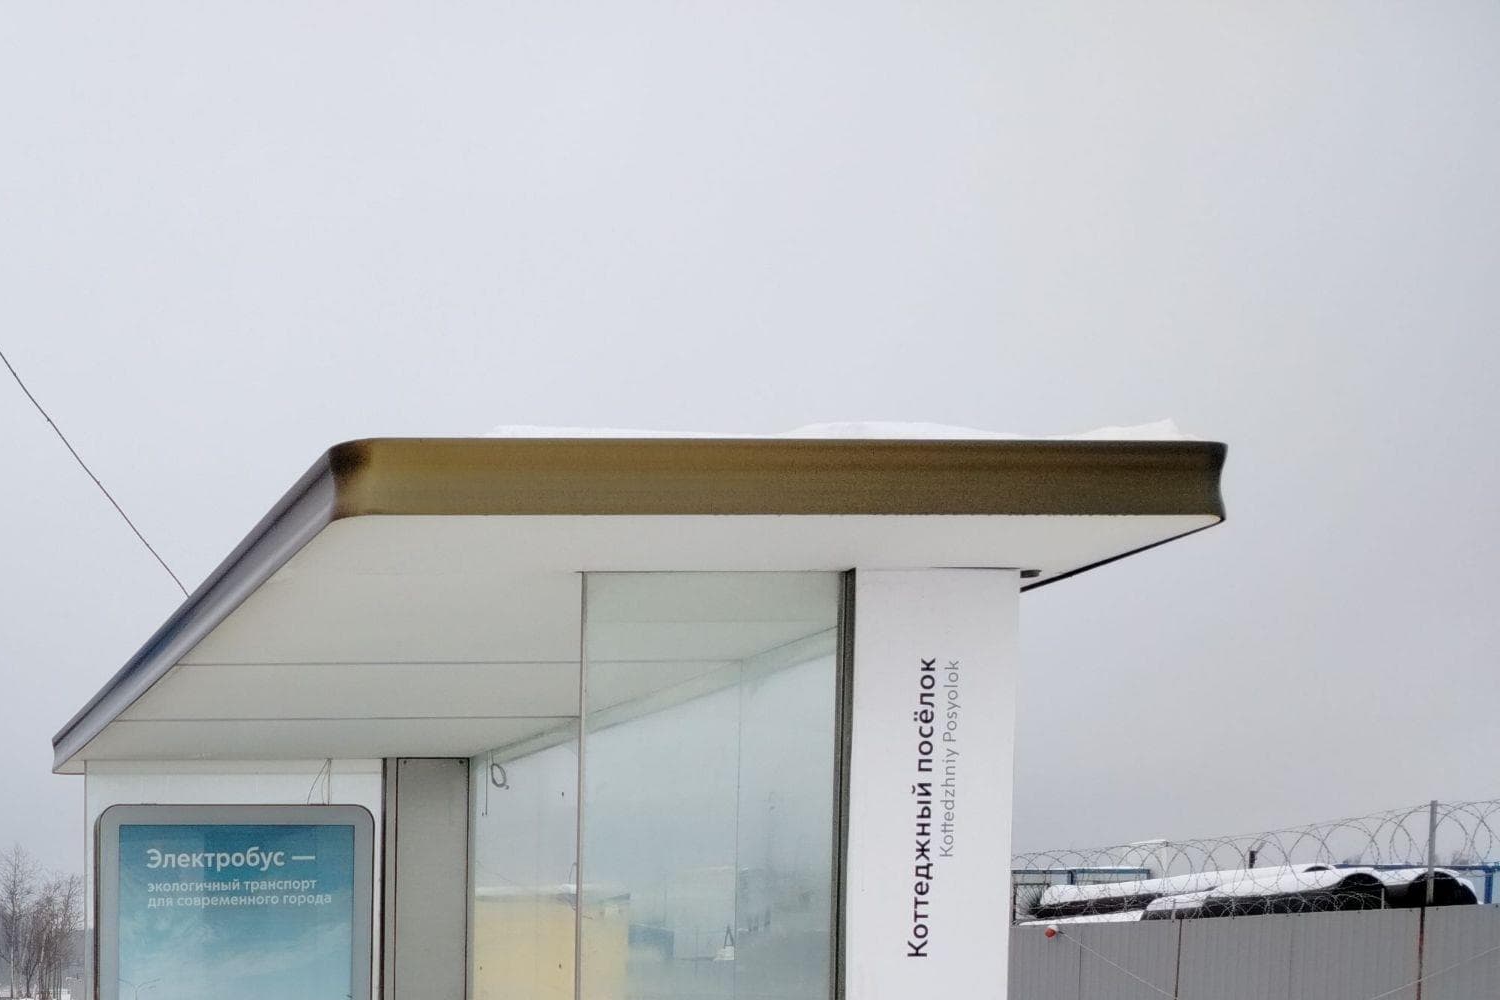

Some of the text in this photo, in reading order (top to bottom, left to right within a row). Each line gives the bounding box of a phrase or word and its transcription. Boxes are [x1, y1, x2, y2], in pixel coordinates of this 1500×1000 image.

[939, 659, 961, 858] Kottedzhniy Posyolok
[907, 657, 936, 958] Коттеджный посёлок
[146, 846, 286, 872] Электробус
[147, 878, 318, 893] экологичный транспорт
[147, 892, 332, 909] для современного города
